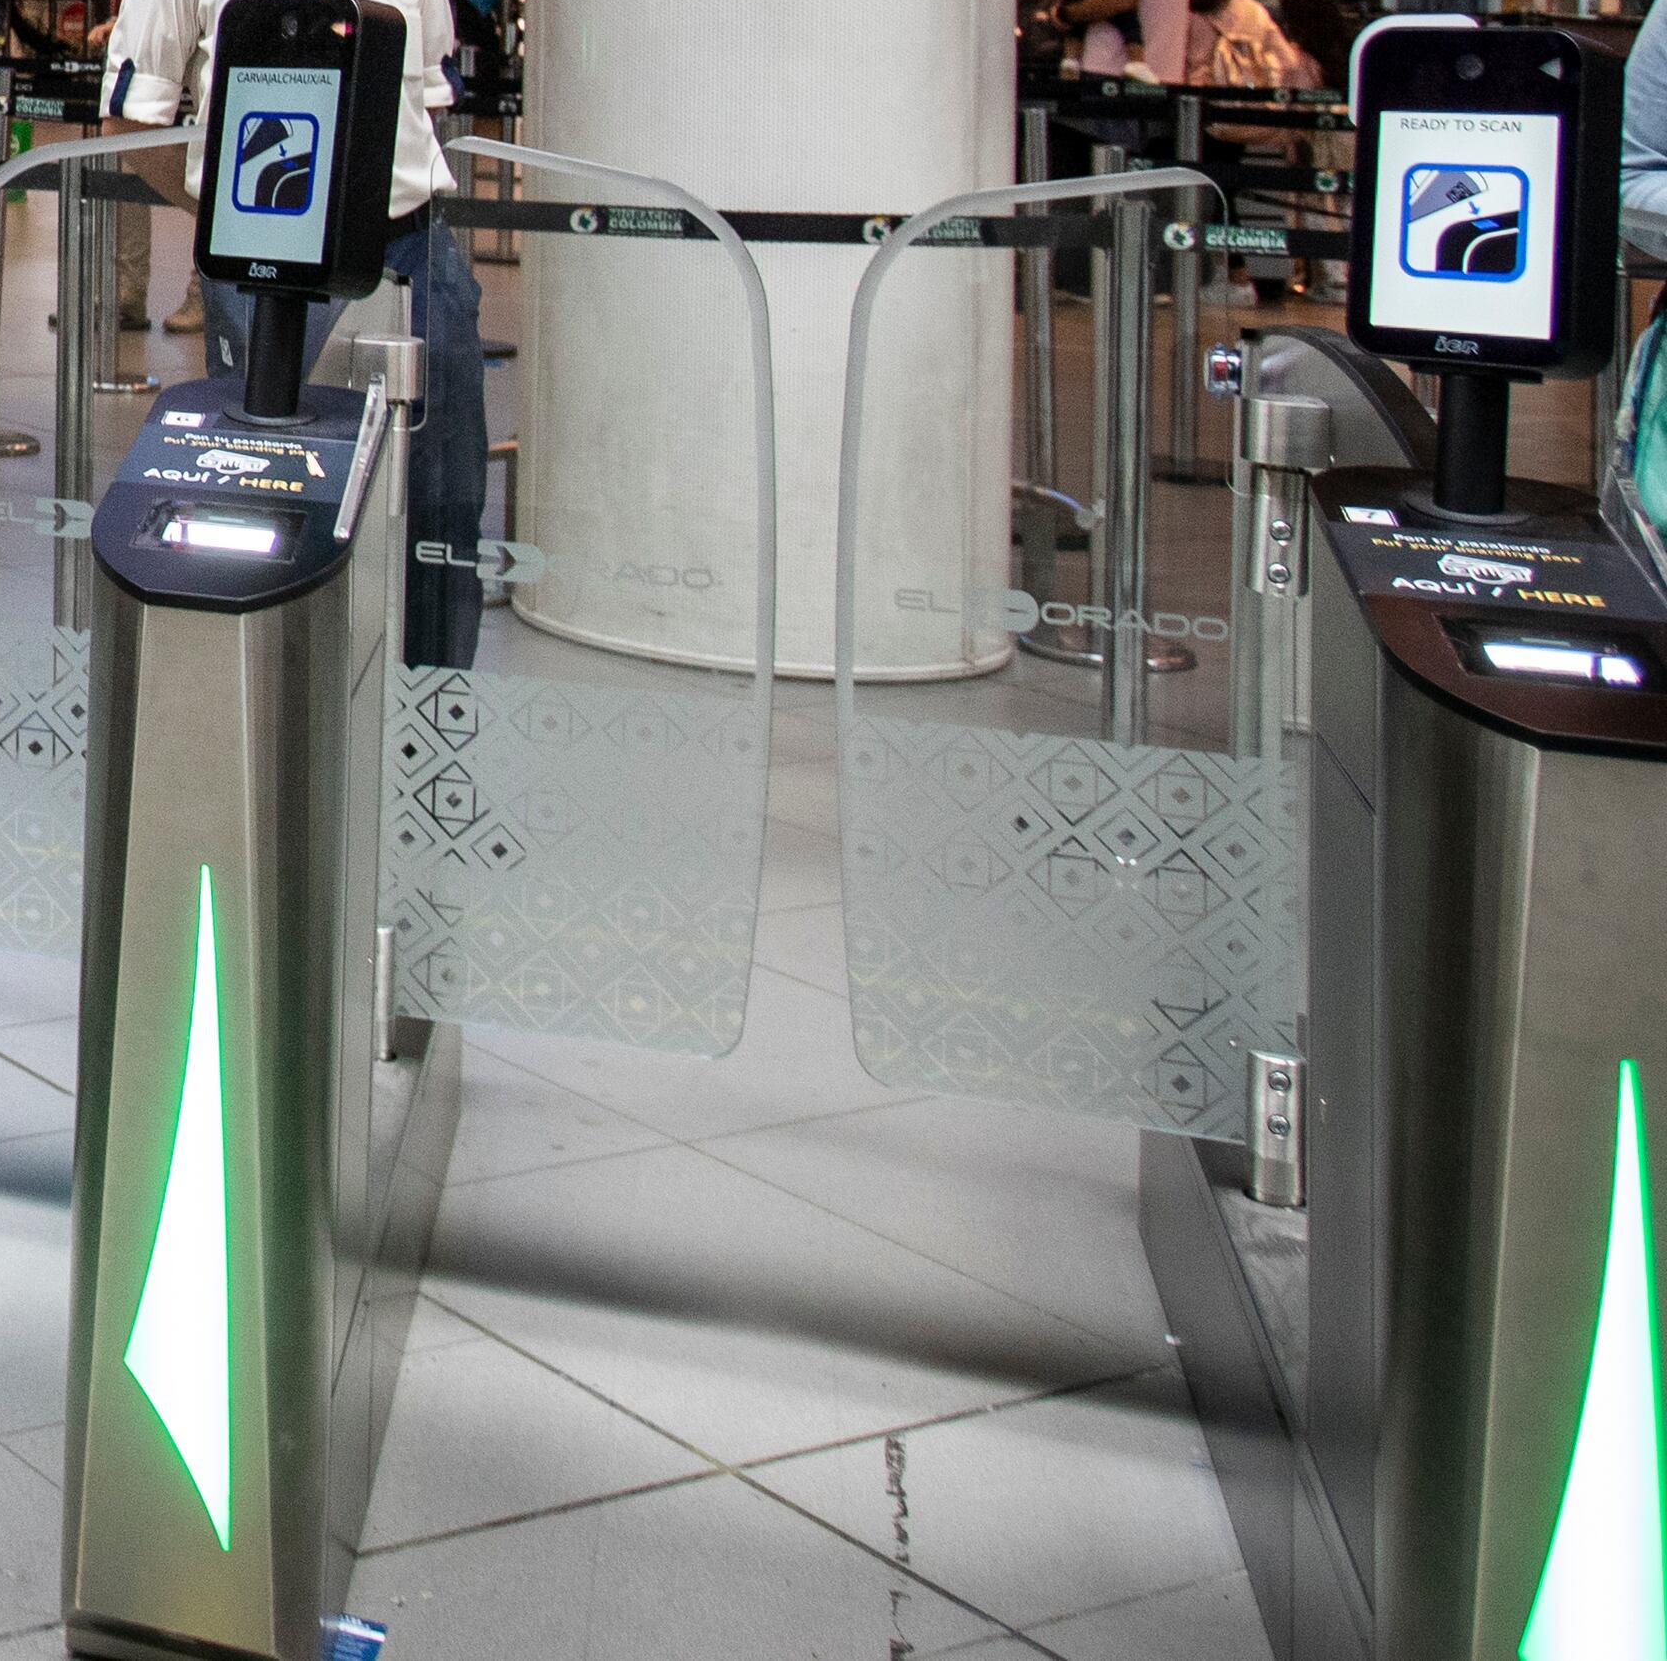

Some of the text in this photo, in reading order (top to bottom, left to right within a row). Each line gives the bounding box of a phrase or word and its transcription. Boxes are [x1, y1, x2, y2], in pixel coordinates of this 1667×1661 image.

[1400, 118, 1522, 133] READY TO SCAN
[609, 217, 683, 231] COLOMBIA
[1207, 235, 1286, 248] COLOMBIA
[232, 438, 303, 450] pasabordo
[238, 476, 305, 492] HERE
[1371, 538, 1582, 564] Put your boarding pass
[1393, 533, 1550, 554] Pon tu pasabordo
[417, 541, 475, 567] EL
[1517, 589, 1606, 608] HERE
[977, 589, 1230, 639] DORADO
